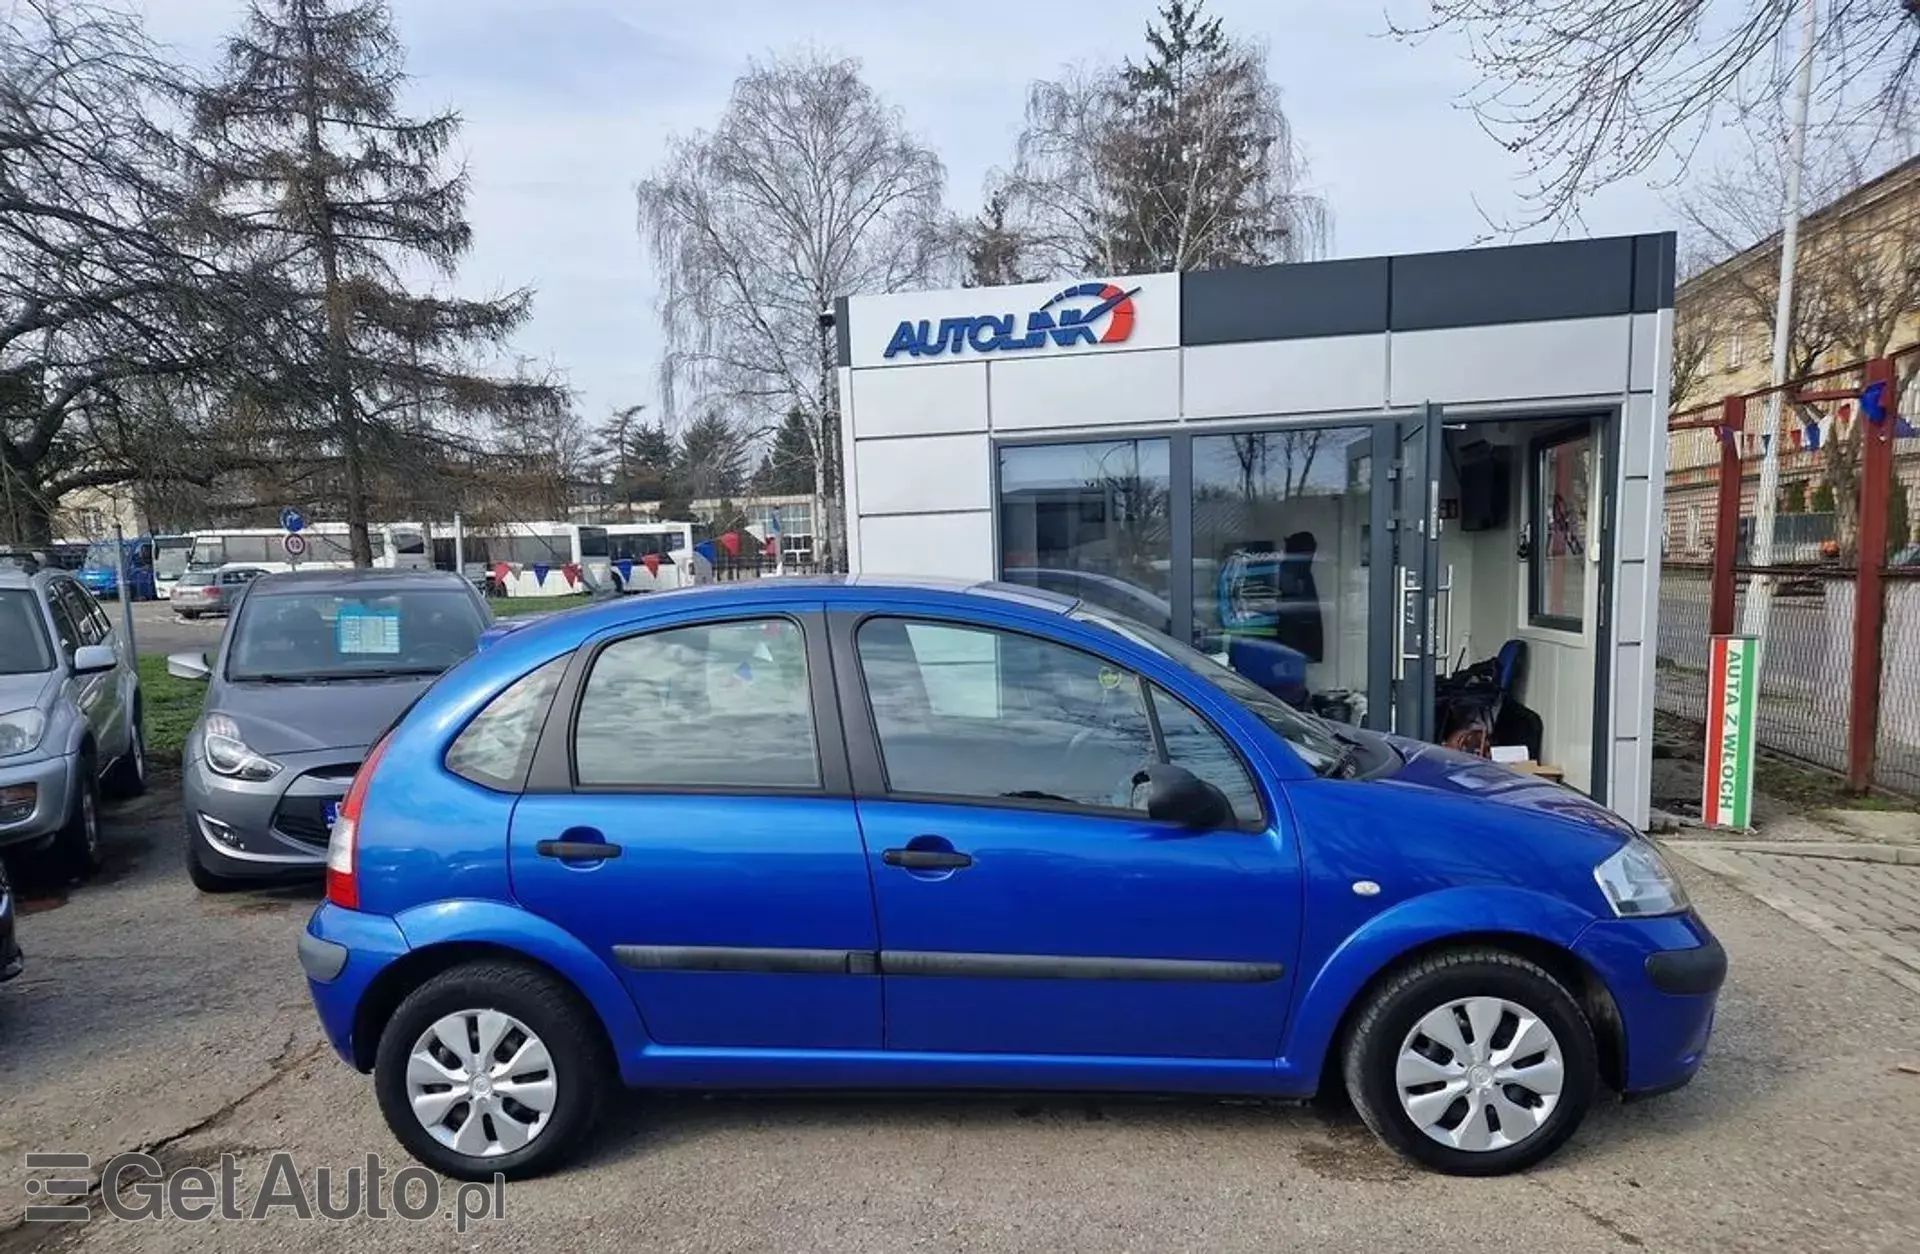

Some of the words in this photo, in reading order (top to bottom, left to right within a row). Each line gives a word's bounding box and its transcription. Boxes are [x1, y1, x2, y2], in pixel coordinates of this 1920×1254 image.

[883, 296, 1114, 357] AUTOLINK
[1726, 650, 1742, 706] AUTA
[1725, 714, 1738, 726] Z
[1720, 734, 1737, 809] WŁOCH
